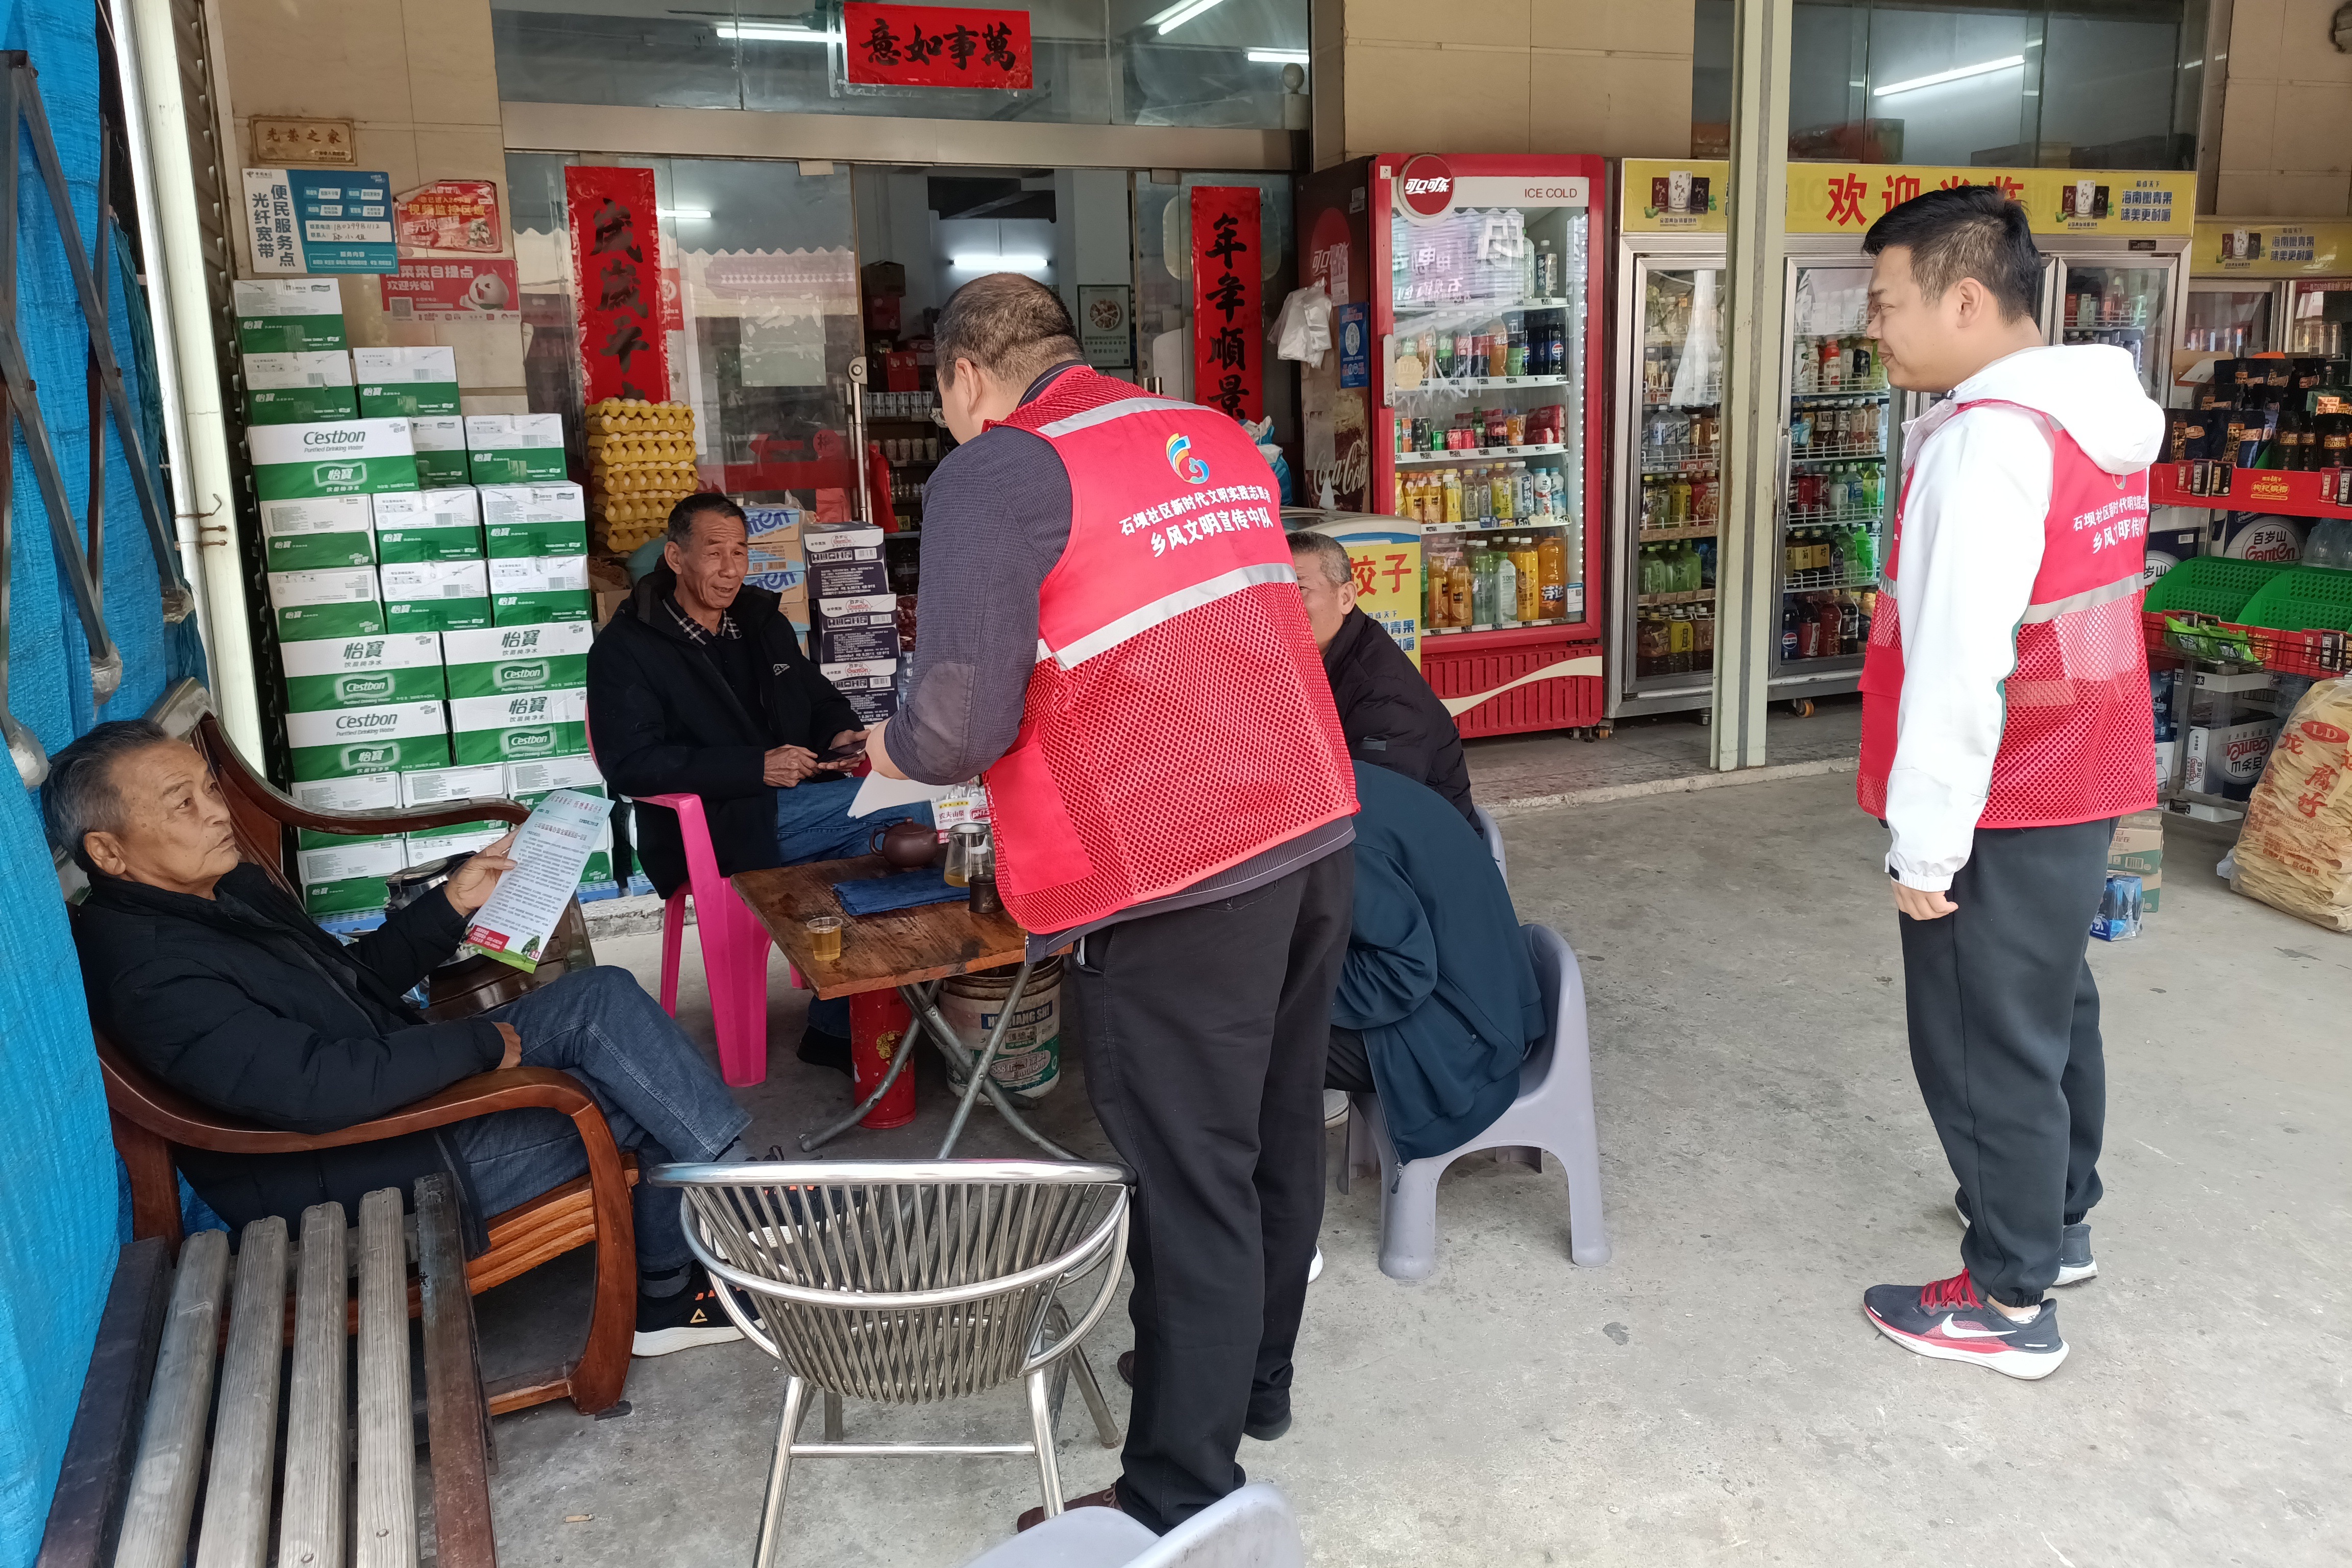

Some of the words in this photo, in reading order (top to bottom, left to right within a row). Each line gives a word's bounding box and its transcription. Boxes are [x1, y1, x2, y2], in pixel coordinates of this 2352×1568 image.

[1405, 177, 1452, 195] 可口可乐
[1525, 188, 1542, 198] ICE
[1546, 188, 1577, 199] COLD
[1826, 173, 2024, 226] 欢迎
[408, 204, 485, 216] 视频监控区域
[252, 192, 275, 258] 光纤宽带
[271, 184, 296, 267] 便民服务点
[1150, 506, 1274, 558] 乡风文明宣传中队
[2253, 531, 2287, 545] 百岁山
[1540, 585, 1564, 601] 芬达
[501, 629, 541, 648] 怡寶
[343, 641, 385, 659] 怡寶
[508, 696, 547, 715] 怡寶
[2312, 724, 2338, 739] LD
[2231, 756, 2262, 773] 百岁山
